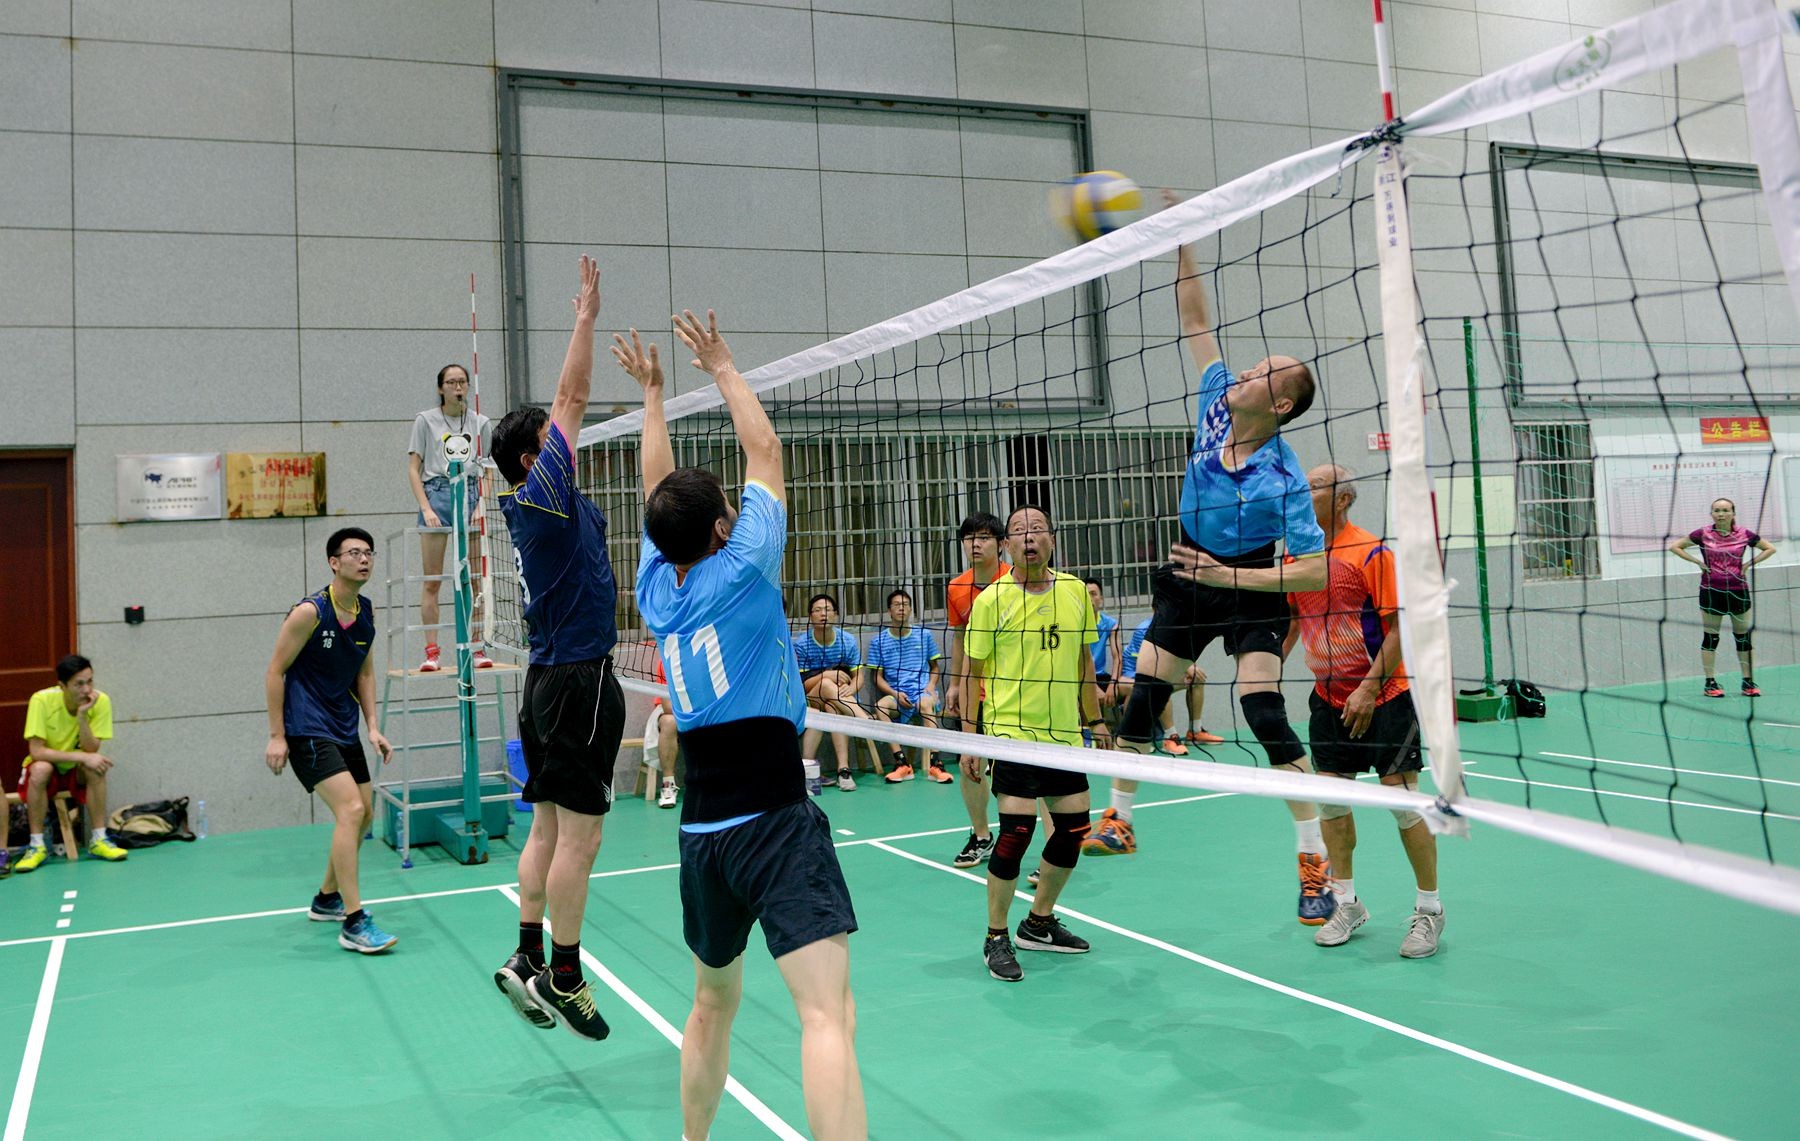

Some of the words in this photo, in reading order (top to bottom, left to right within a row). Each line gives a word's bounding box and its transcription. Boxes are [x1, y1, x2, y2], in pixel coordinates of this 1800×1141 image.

[1711, 420, 1761, 439] 公告栏
[322, 638, 333, 649] 18
[1040, 623, 1060, 651] 15
[664, 623, 731, 713] 11
